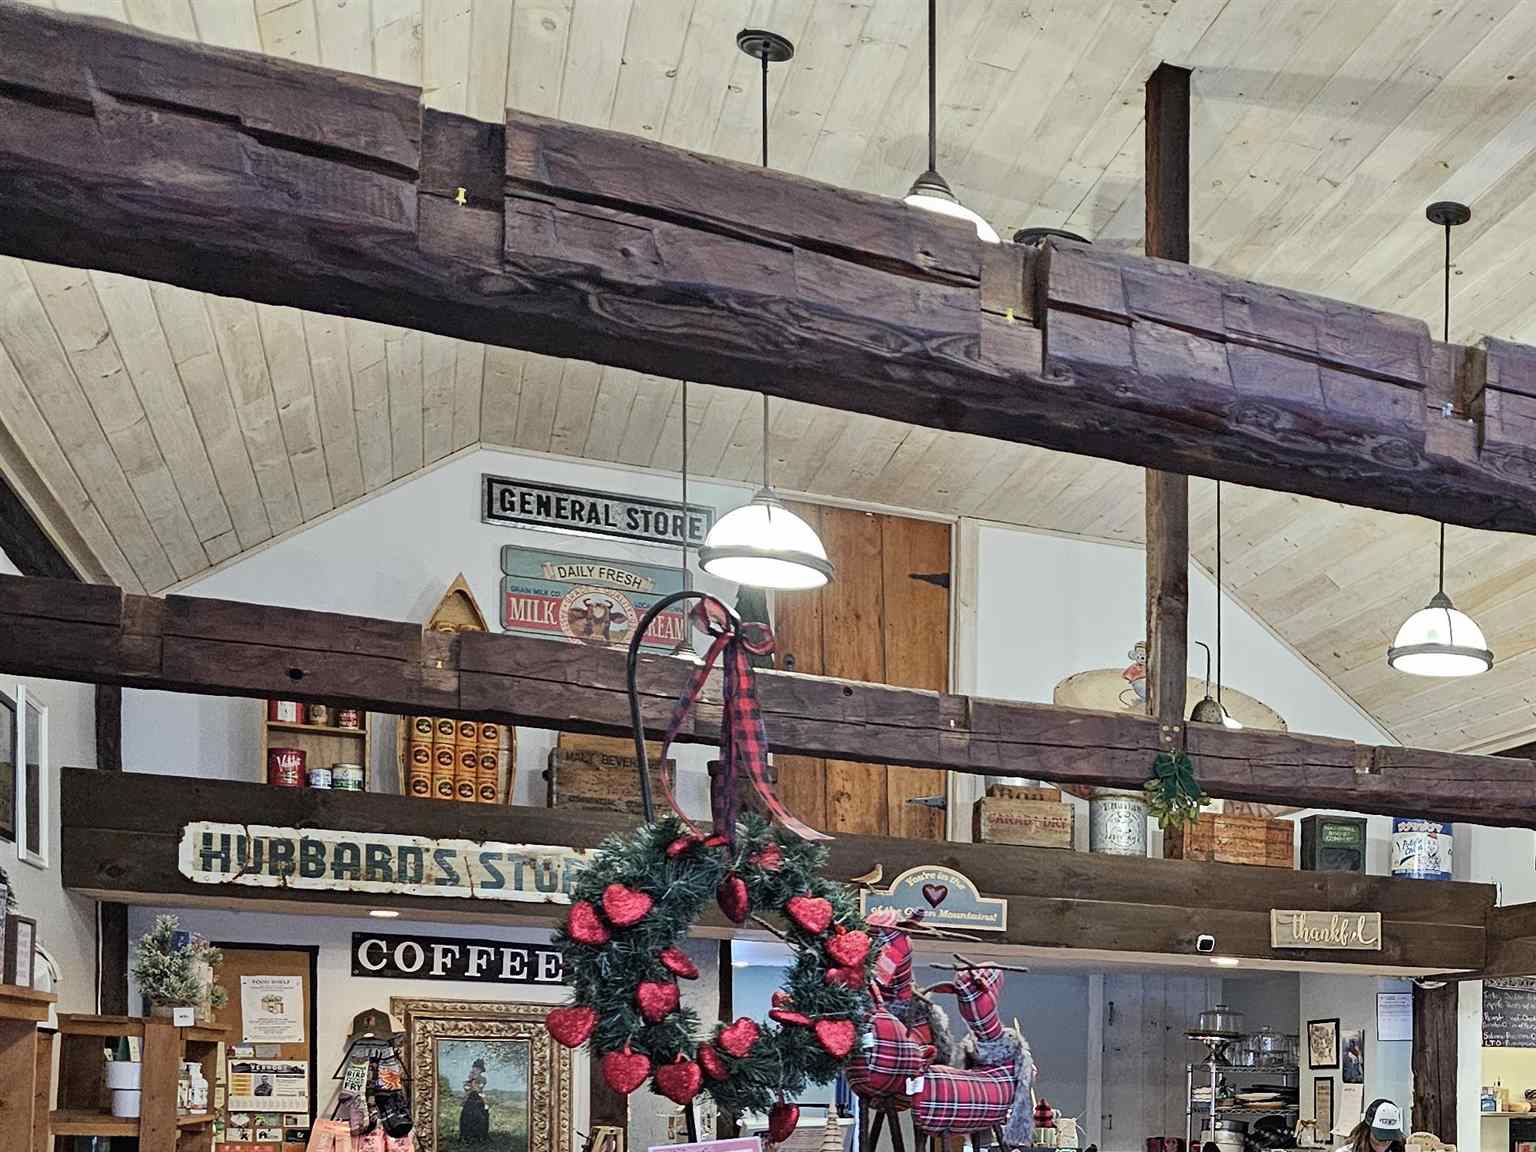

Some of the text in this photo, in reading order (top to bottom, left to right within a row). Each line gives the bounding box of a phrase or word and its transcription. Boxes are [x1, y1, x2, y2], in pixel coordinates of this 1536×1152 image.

[499, 487, 704, 541] GENERAL STORE
[557, 565, 643, 590] DAILY FRESH
[509, 596, 558, 626] MILK
[358, 937, 565, 983] COFFEE
